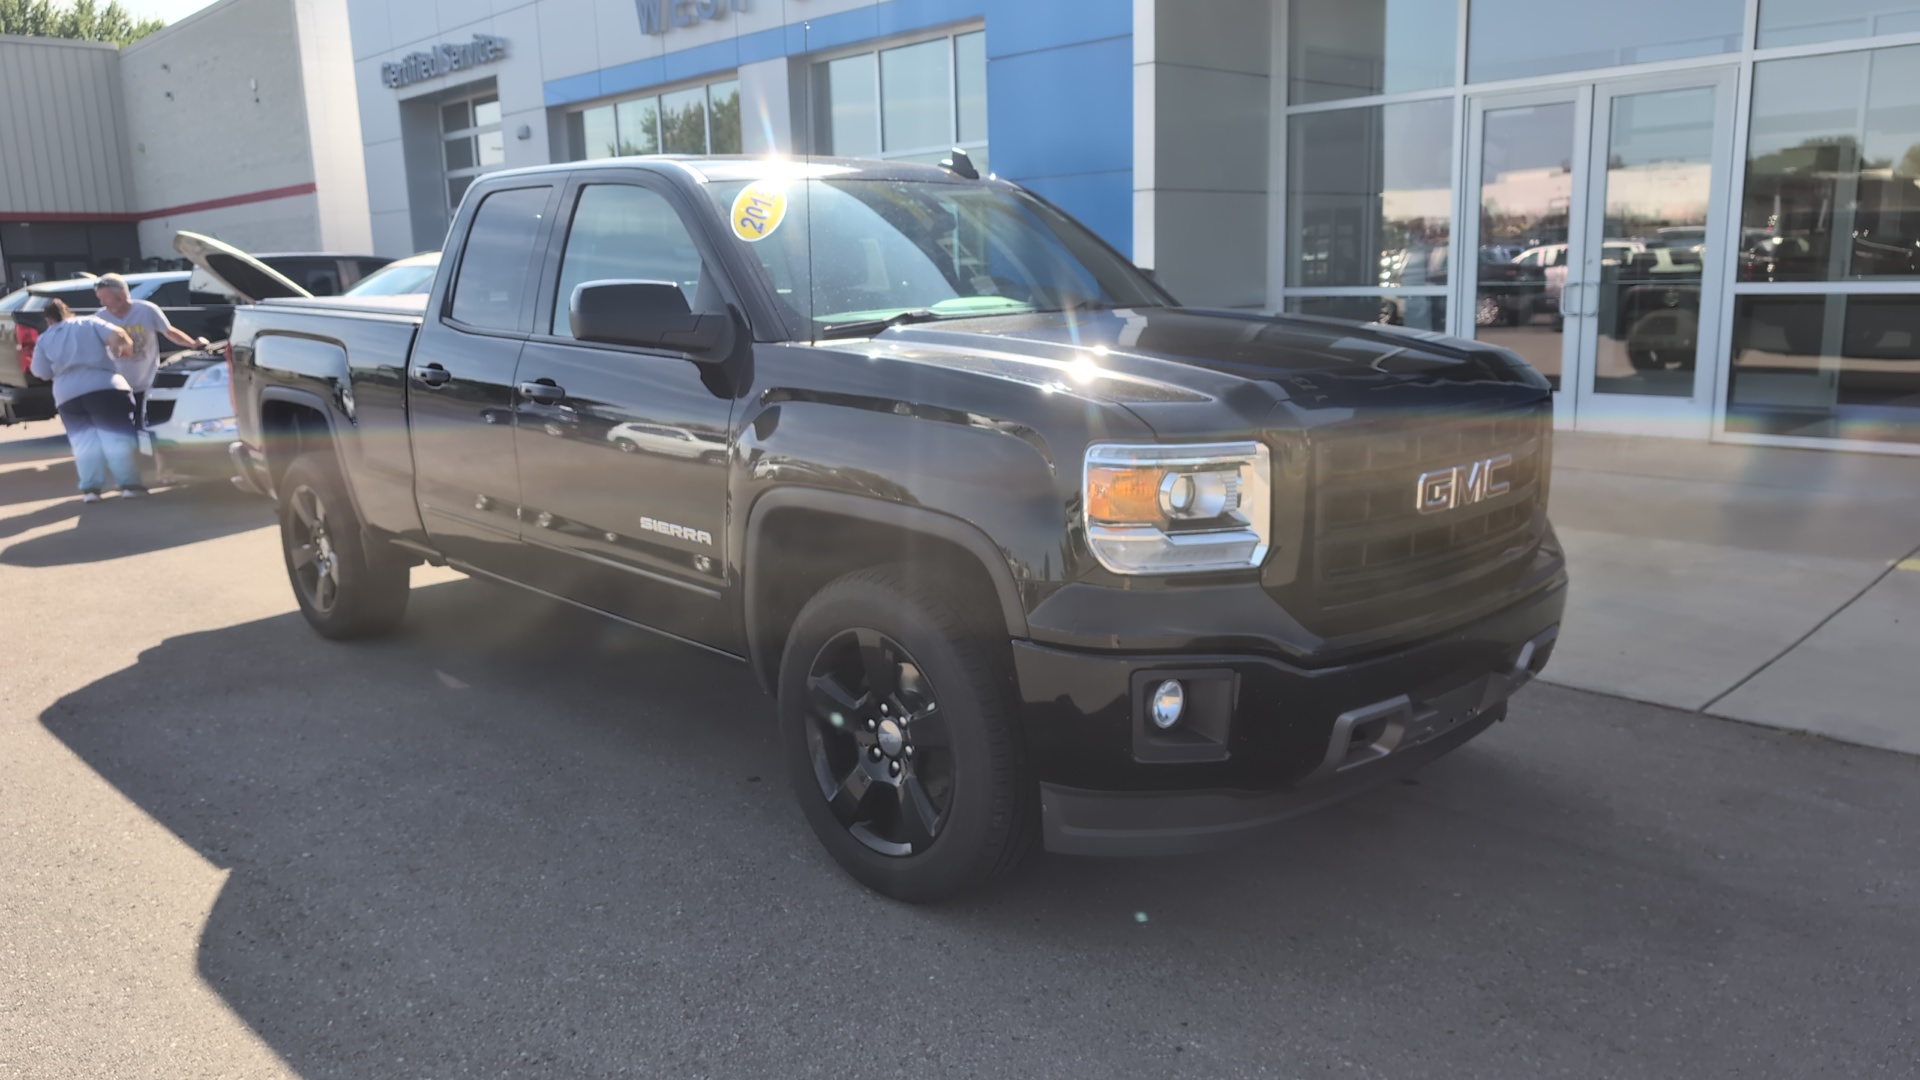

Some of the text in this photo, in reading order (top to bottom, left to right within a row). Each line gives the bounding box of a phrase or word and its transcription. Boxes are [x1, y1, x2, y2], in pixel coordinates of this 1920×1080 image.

[635, 0, 748, 35] WE
[381, 45, 439, 89] Certified
[740, 188, 776, 235] 201
[1416, 453, 1513, 515] GMC
[640, 516, 712, 547] SIERRA
